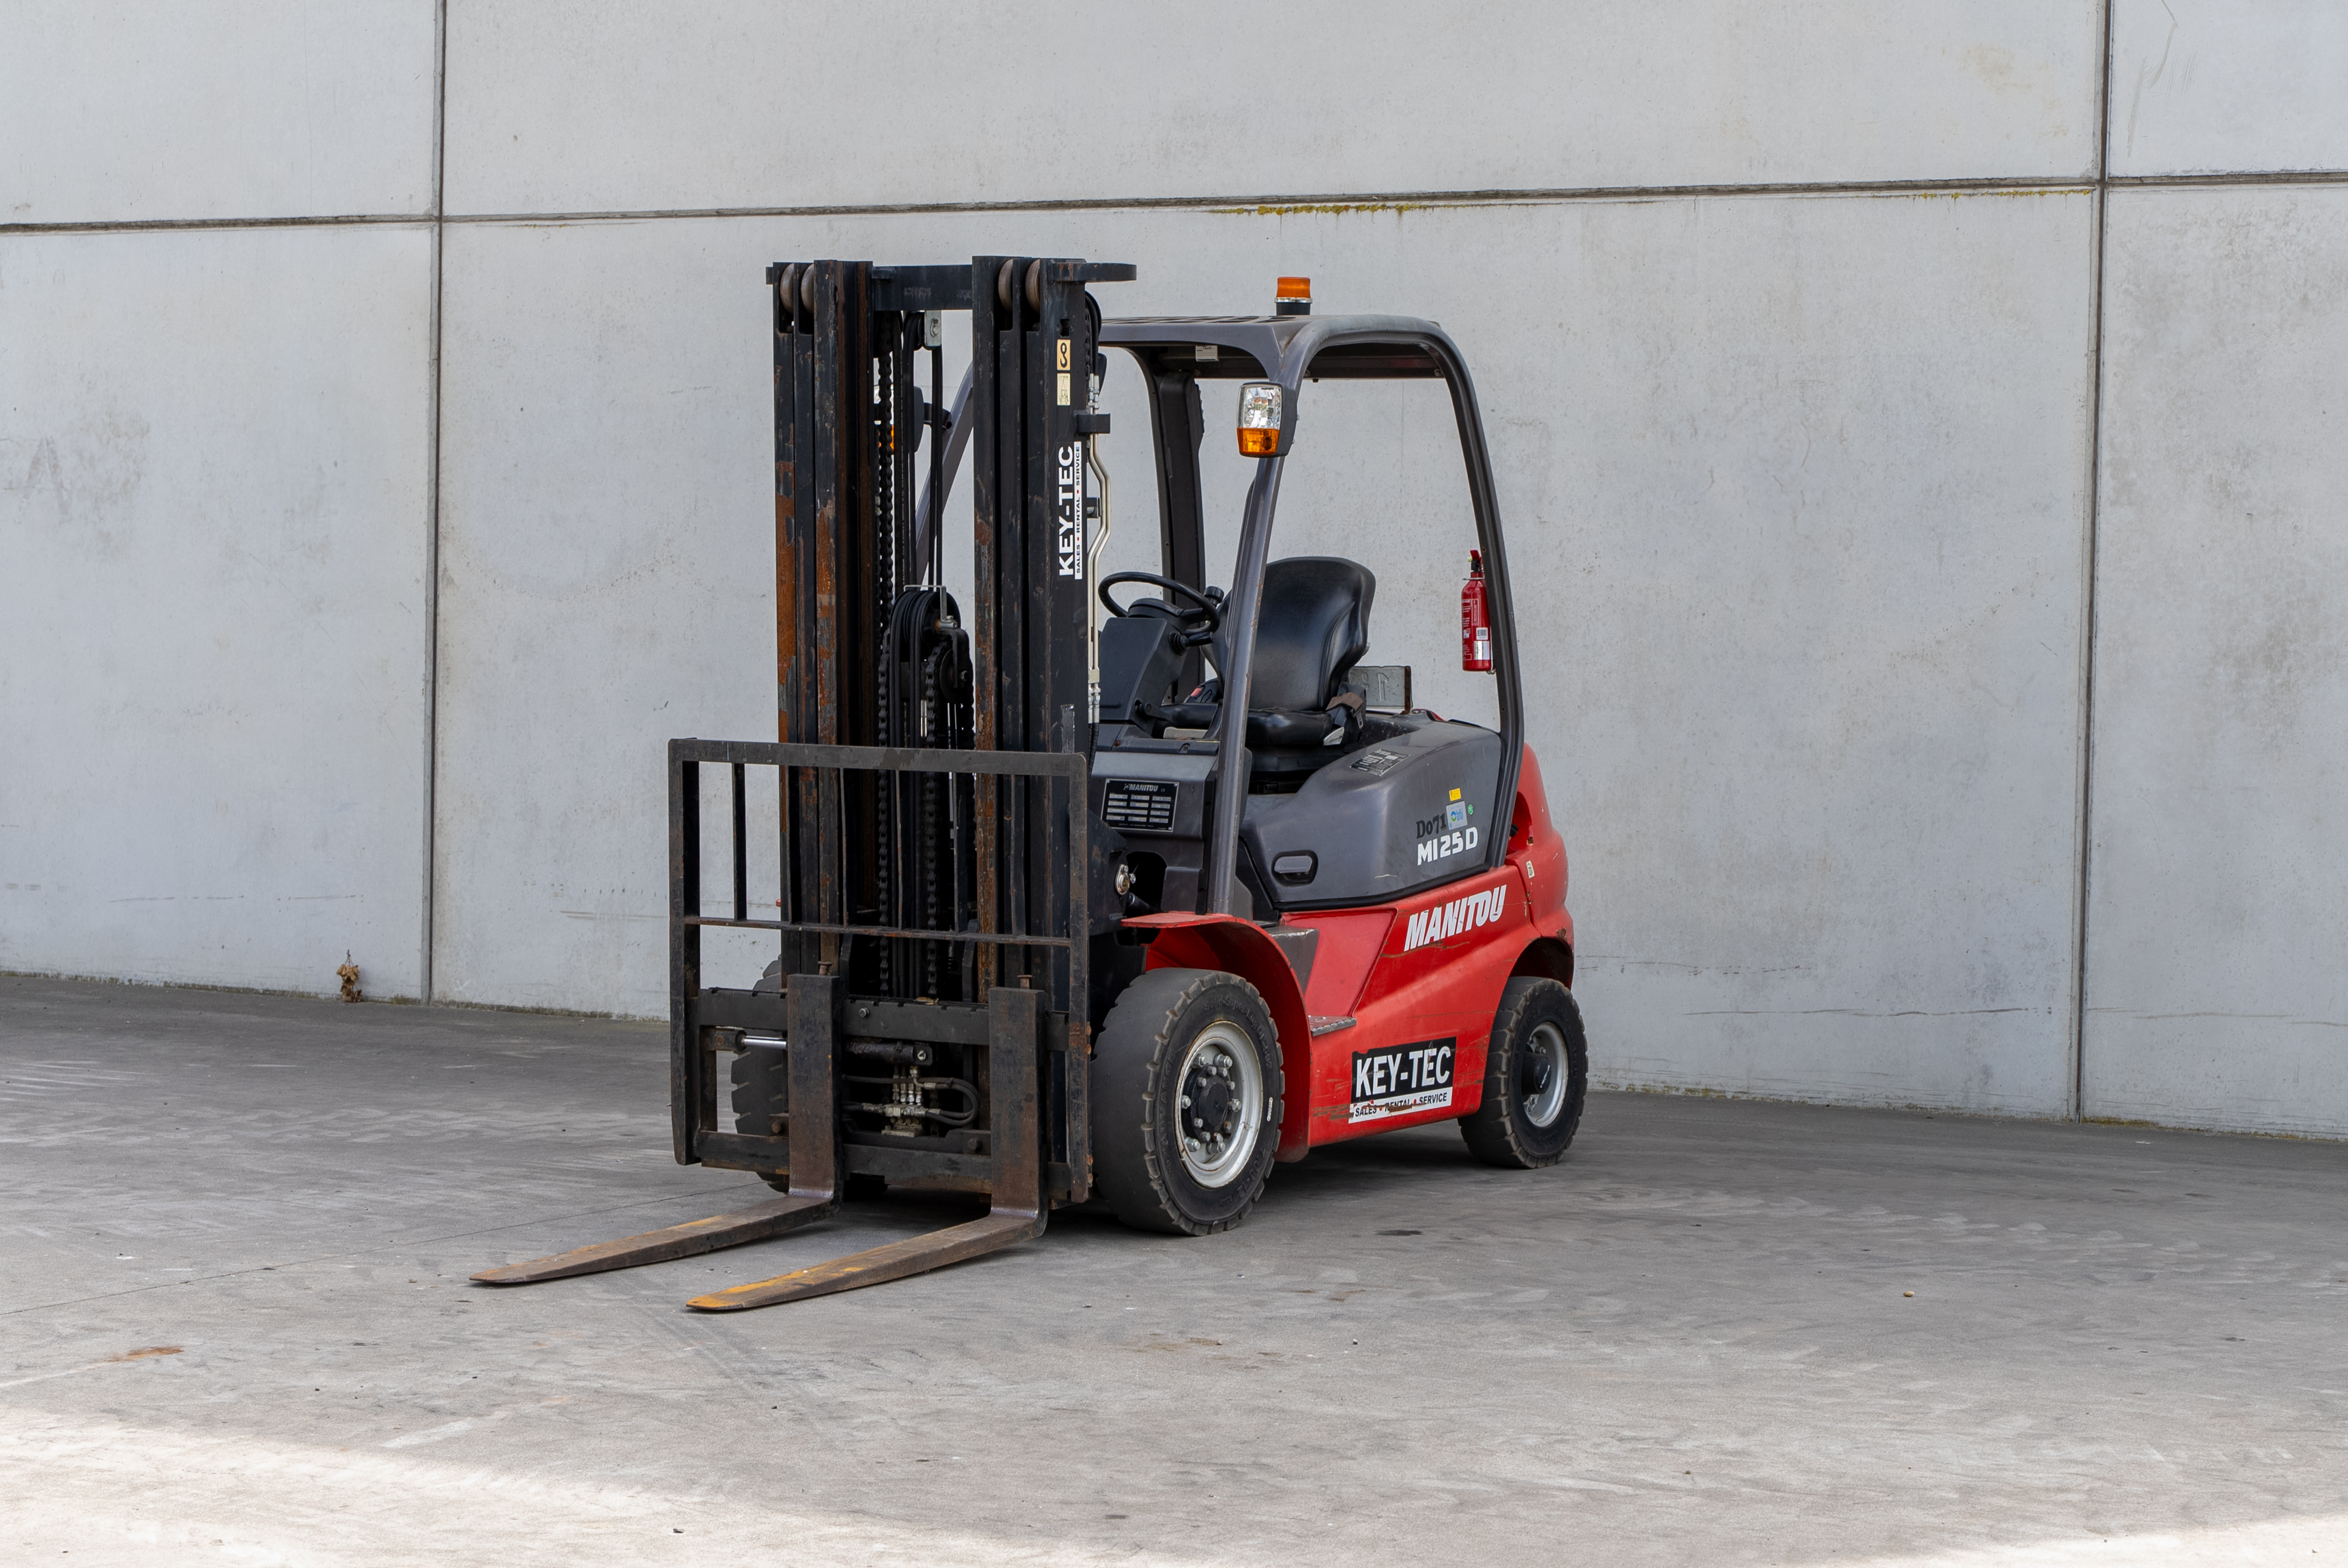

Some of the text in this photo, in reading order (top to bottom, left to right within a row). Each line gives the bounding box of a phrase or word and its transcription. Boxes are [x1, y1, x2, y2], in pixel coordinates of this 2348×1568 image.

[1058, 445, 1073, 576] KEY-TEC
[1129, 783, 1159, 792] MANITOU
[1404, 885, 1507, 952] MANITOU
[1356, 1046, 1451, 1098] KEY-TEC
[1355, 1105, 1377, 1117] SALES
[1419, 1092, 1447, 1105] SERVICE
